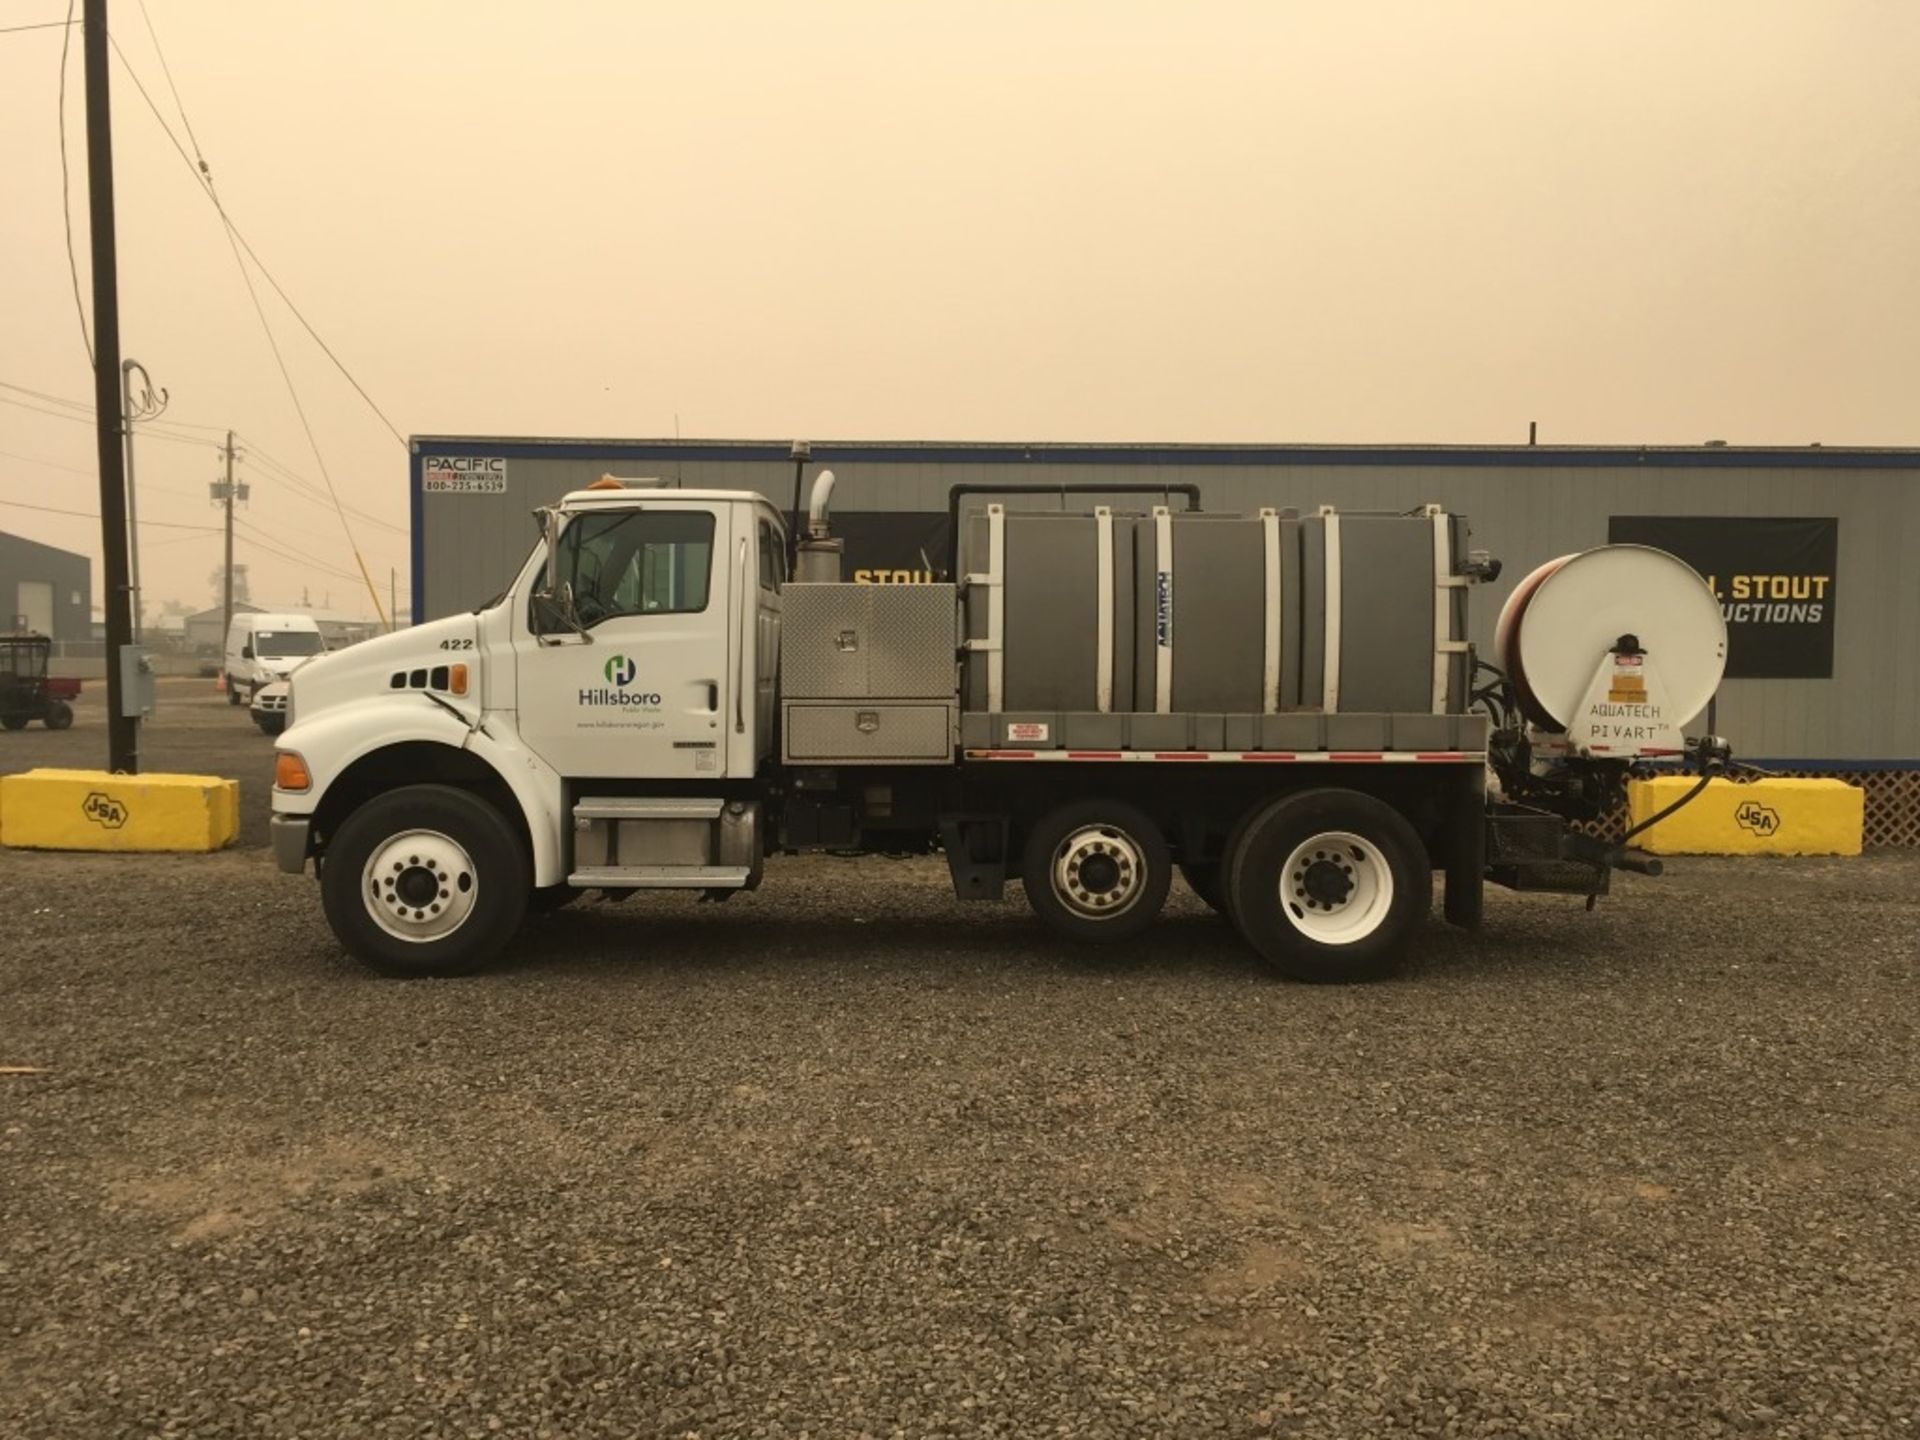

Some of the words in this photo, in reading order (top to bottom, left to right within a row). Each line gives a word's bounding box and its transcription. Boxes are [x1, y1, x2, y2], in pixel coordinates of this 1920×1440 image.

[854, 569, 932, 585] STOU
[1732, 575, 1829, 599] STOUT
[1720, 603, 1823, 623] UCTIONS
[440, 639, 473, 650] 422
[579, 689, 661, 706] Hillsboro
[1590, 704, 1661, 718] AQUATECH
[88, 798, 121, 822] JSA
[1739, 806, 1772, 829] JSA
